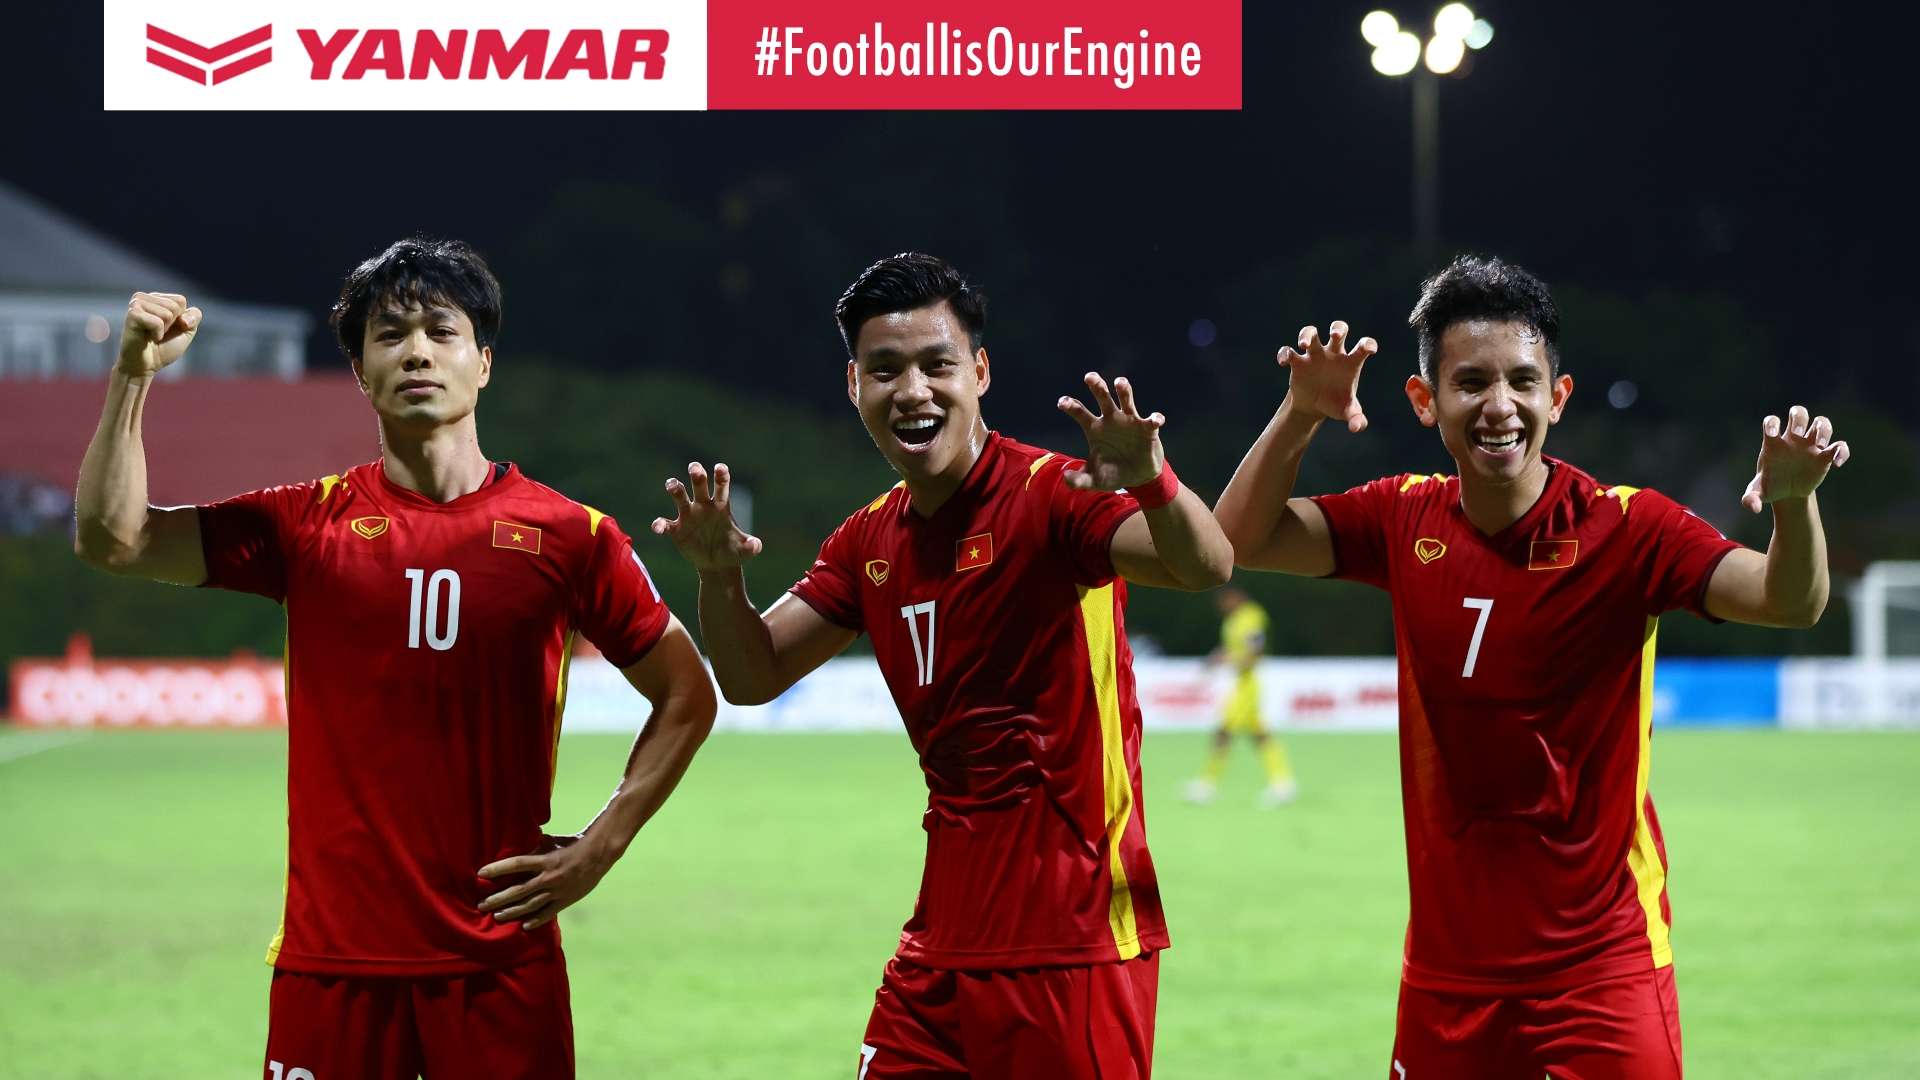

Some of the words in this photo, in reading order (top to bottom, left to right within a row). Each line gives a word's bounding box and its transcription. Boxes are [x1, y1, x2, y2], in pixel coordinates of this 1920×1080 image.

[405, 568, 461, 651] 10
[900, 599, 936, 687] 17
[1461, 597, 1495, 678] 7
